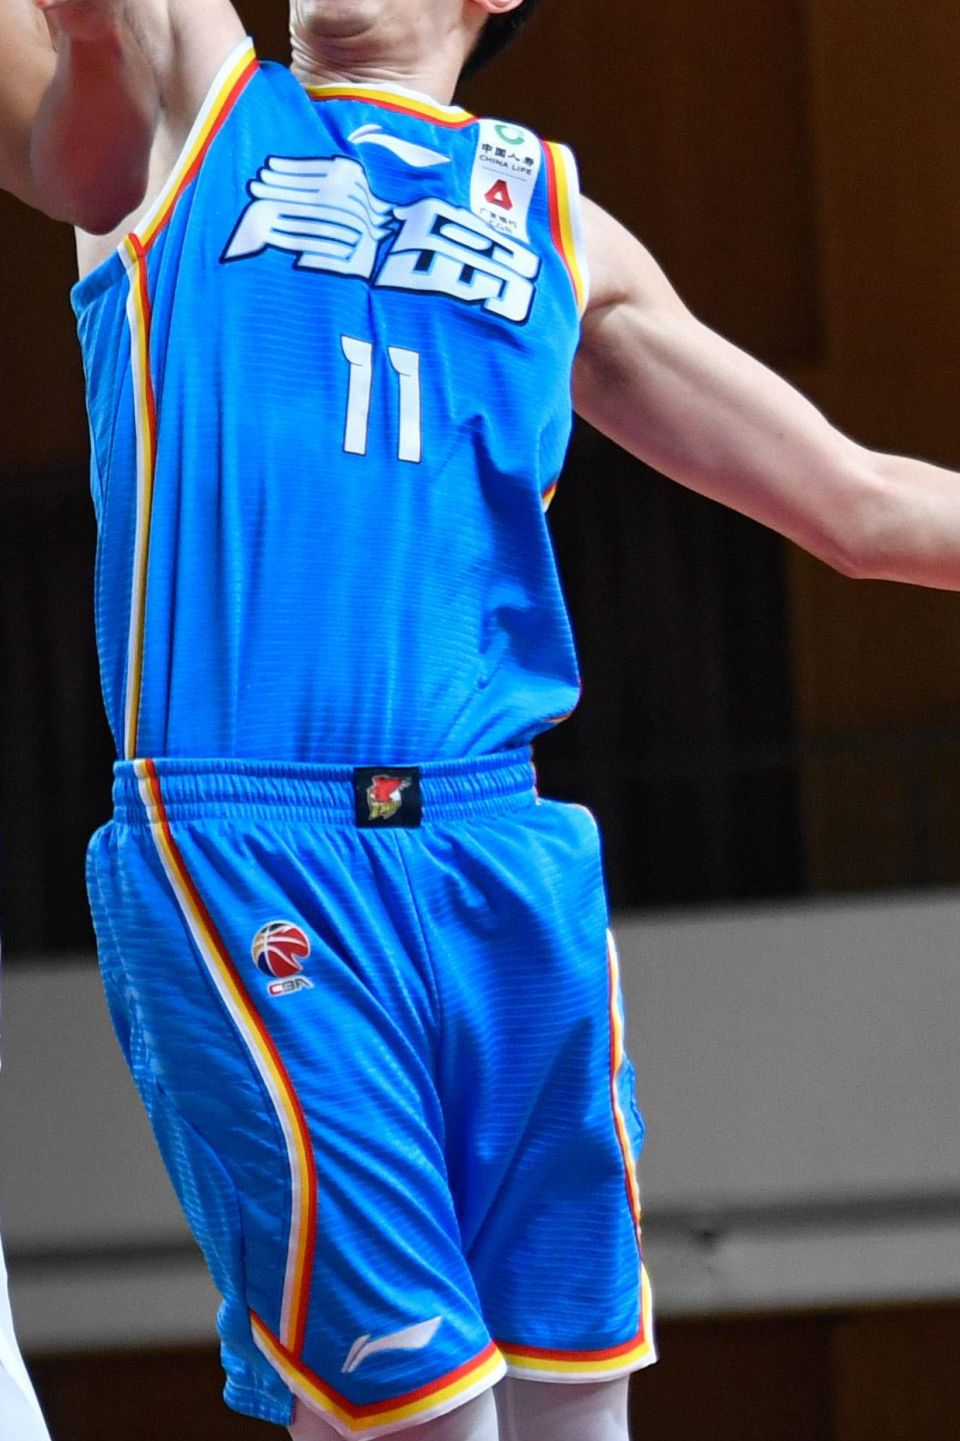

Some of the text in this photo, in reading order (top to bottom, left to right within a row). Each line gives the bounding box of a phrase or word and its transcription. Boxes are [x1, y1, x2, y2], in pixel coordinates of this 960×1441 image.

[479, 154, 532, 175] CHINA LIFE
[481, 143, 534, 167] 中国人寿
[341, 335, 421, 464] 11
[268, 977, 312, 996] CBA
